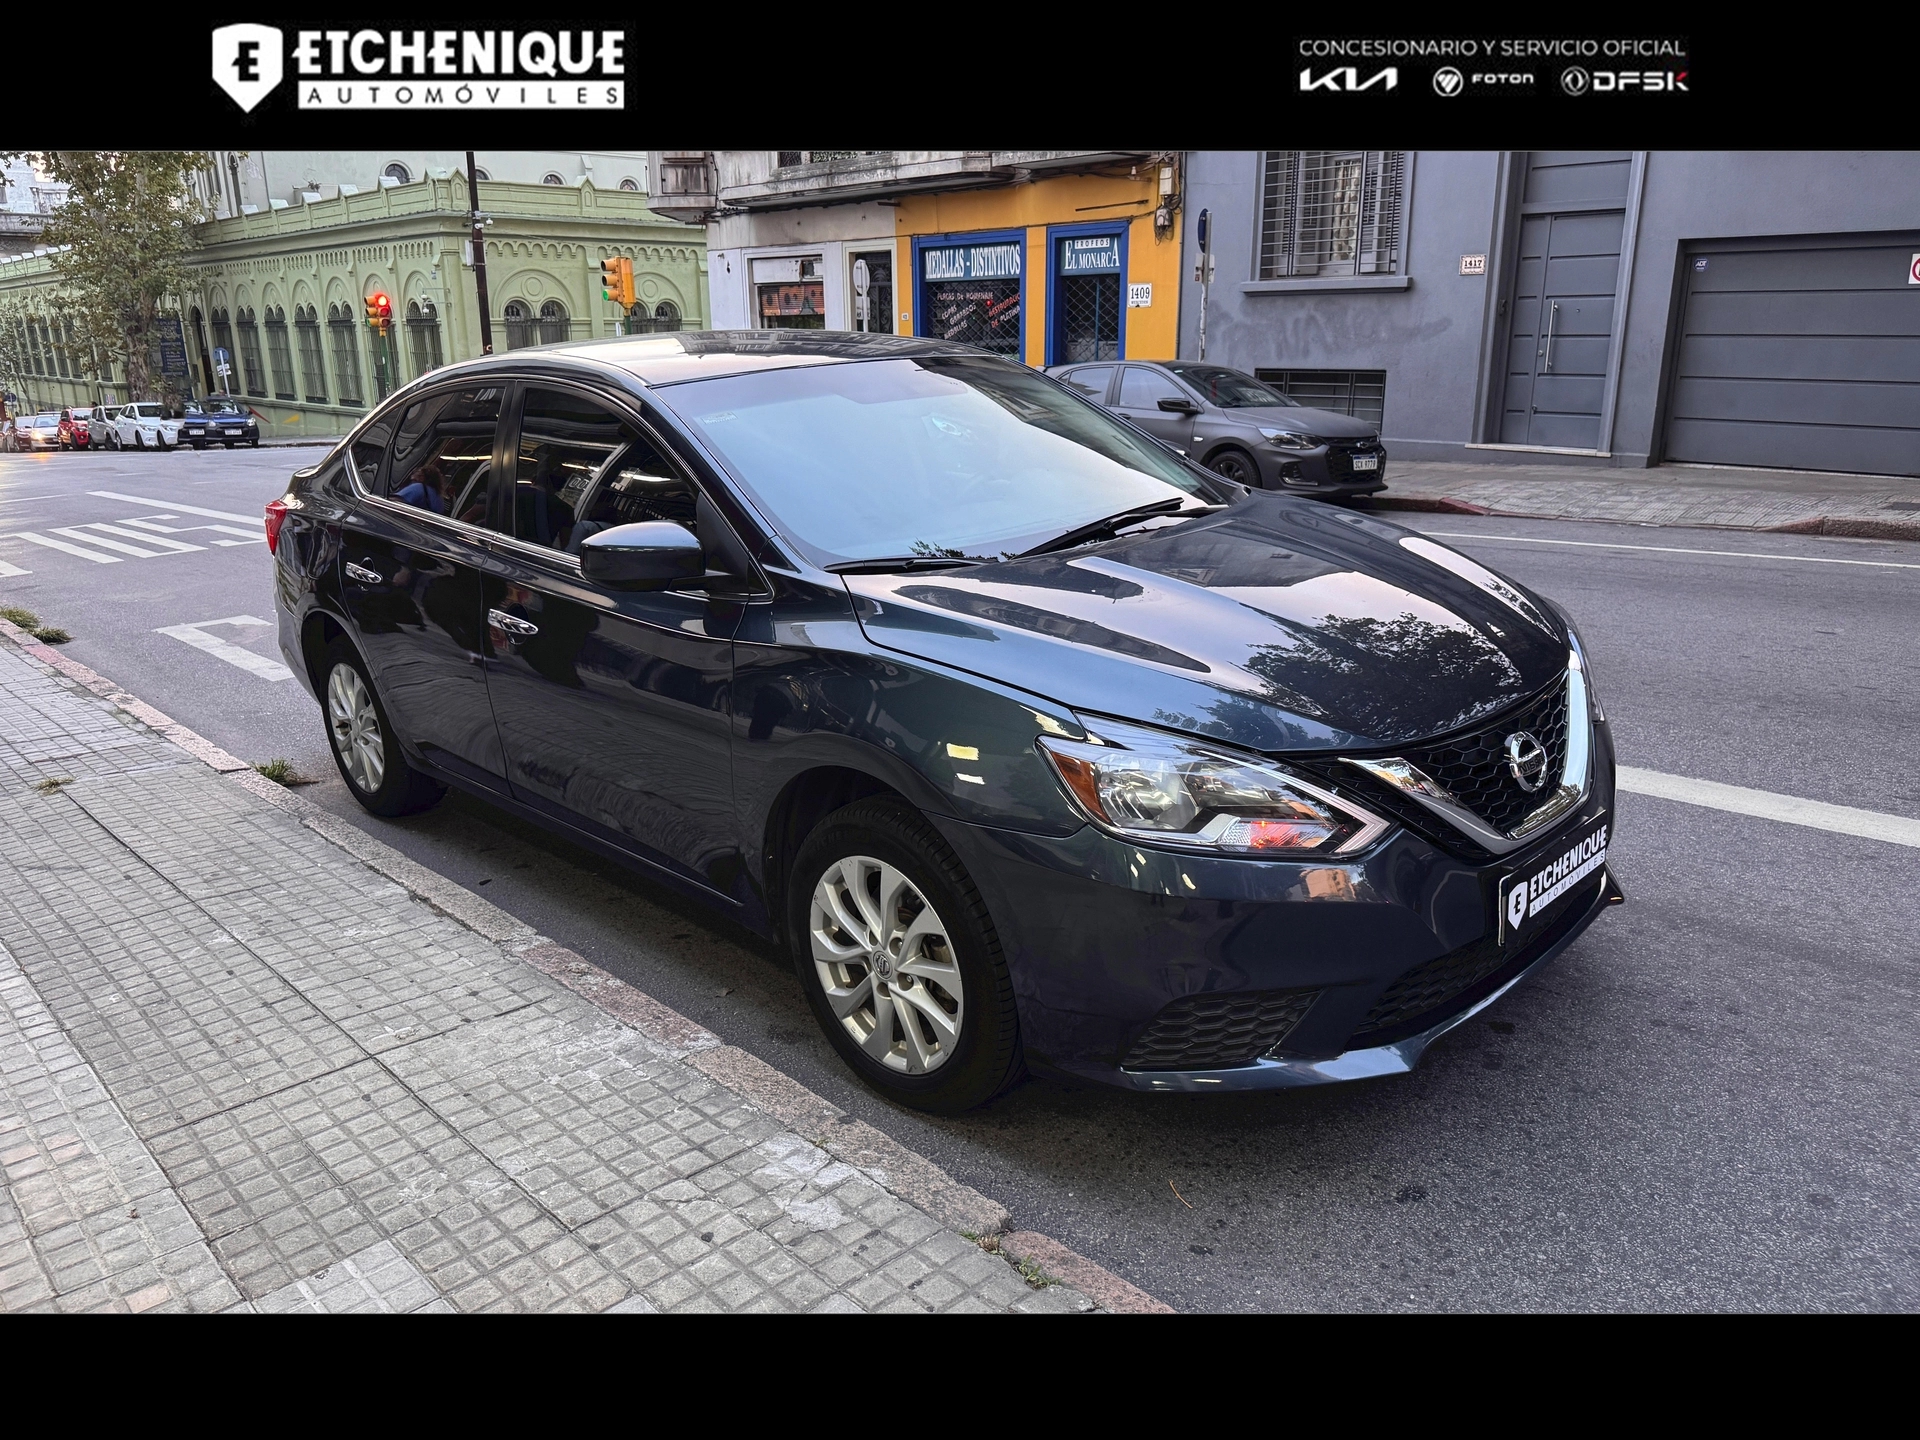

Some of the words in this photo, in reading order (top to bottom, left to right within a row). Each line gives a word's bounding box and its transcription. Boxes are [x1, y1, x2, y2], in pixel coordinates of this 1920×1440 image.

[1075, 238, 1110, 248] TROFEOS
[1078, 237, 1120, 269] MONARCA
[925, 248, 965, 279] MEDALLAS
[970, 244, 1021, 277] DISTINTIVOS
[1131, 286, 1150, 300] 1409
[1529, 824, 1607, 901] ETCHENIQUE
